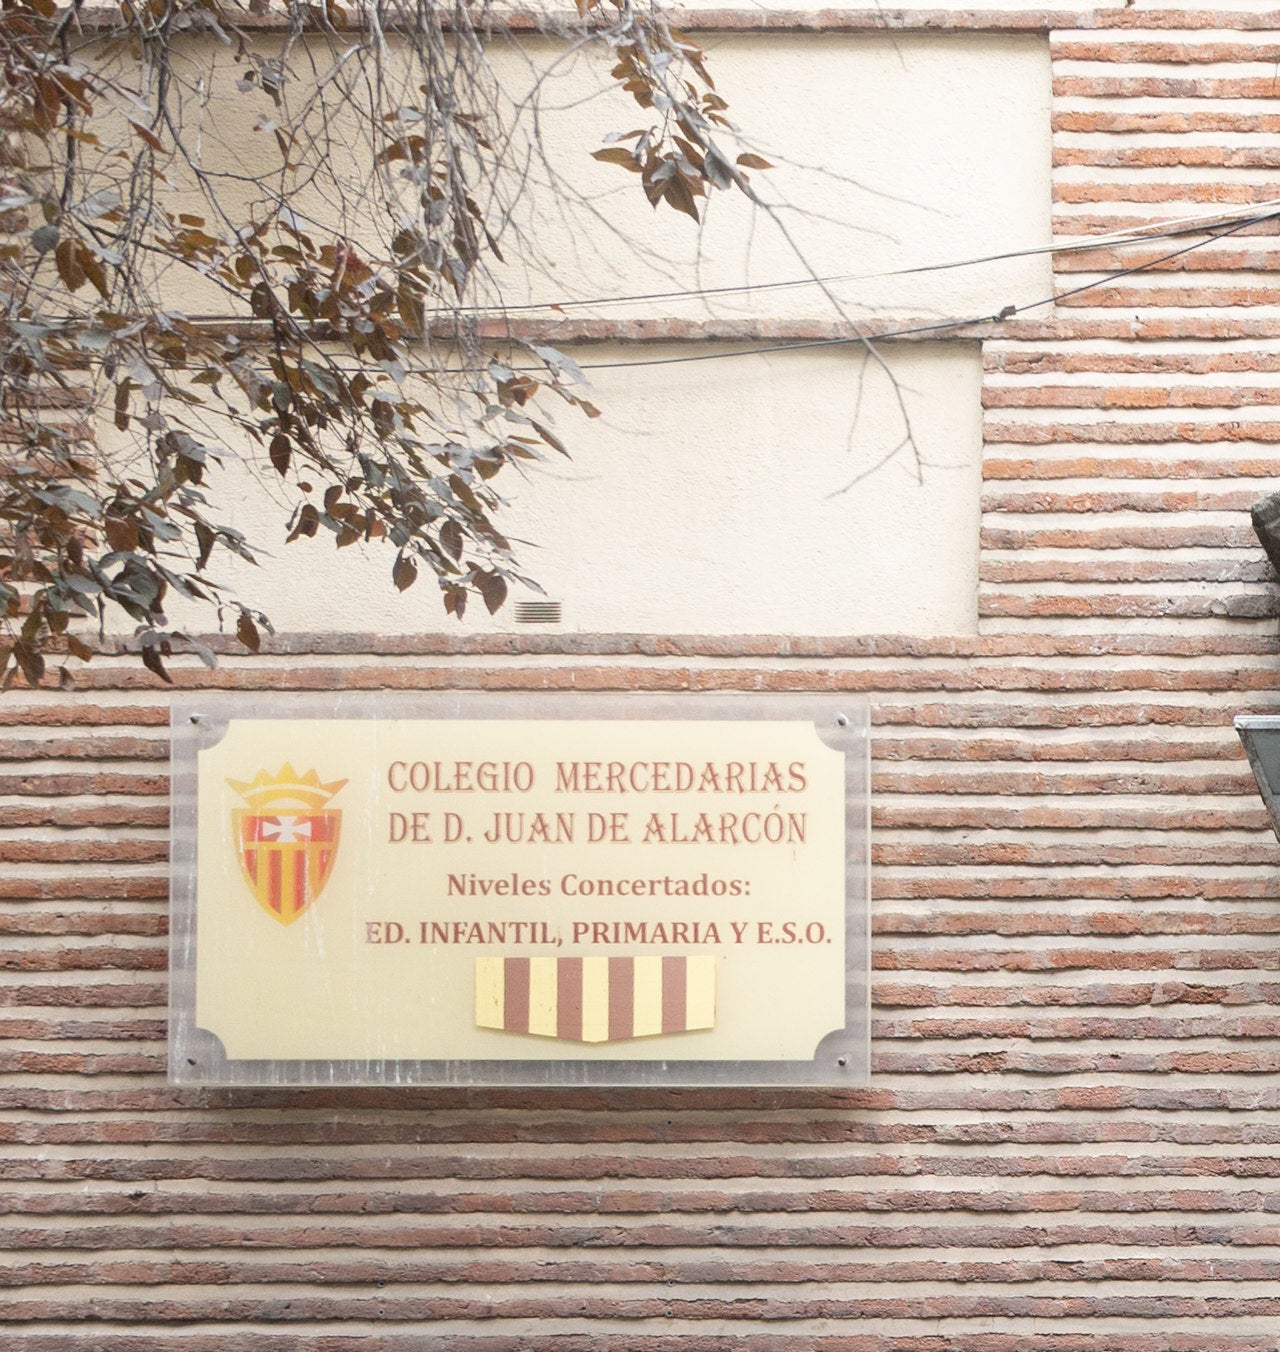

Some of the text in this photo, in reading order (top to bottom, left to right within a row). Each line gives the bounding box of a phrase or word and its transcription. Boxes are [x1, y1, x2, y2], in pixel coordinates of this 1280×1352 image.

[387, 760, 808, 794] COLEGIO MERCEDARIAS
[388, 804, 809, 848] DE D. JUAN DE ALARCÓN
[447, 872, 752, 898] Niveles Concertados:
[365, 921, 833, 949] ED. INFANTIL, PRIMARIA Y E.S.O.
